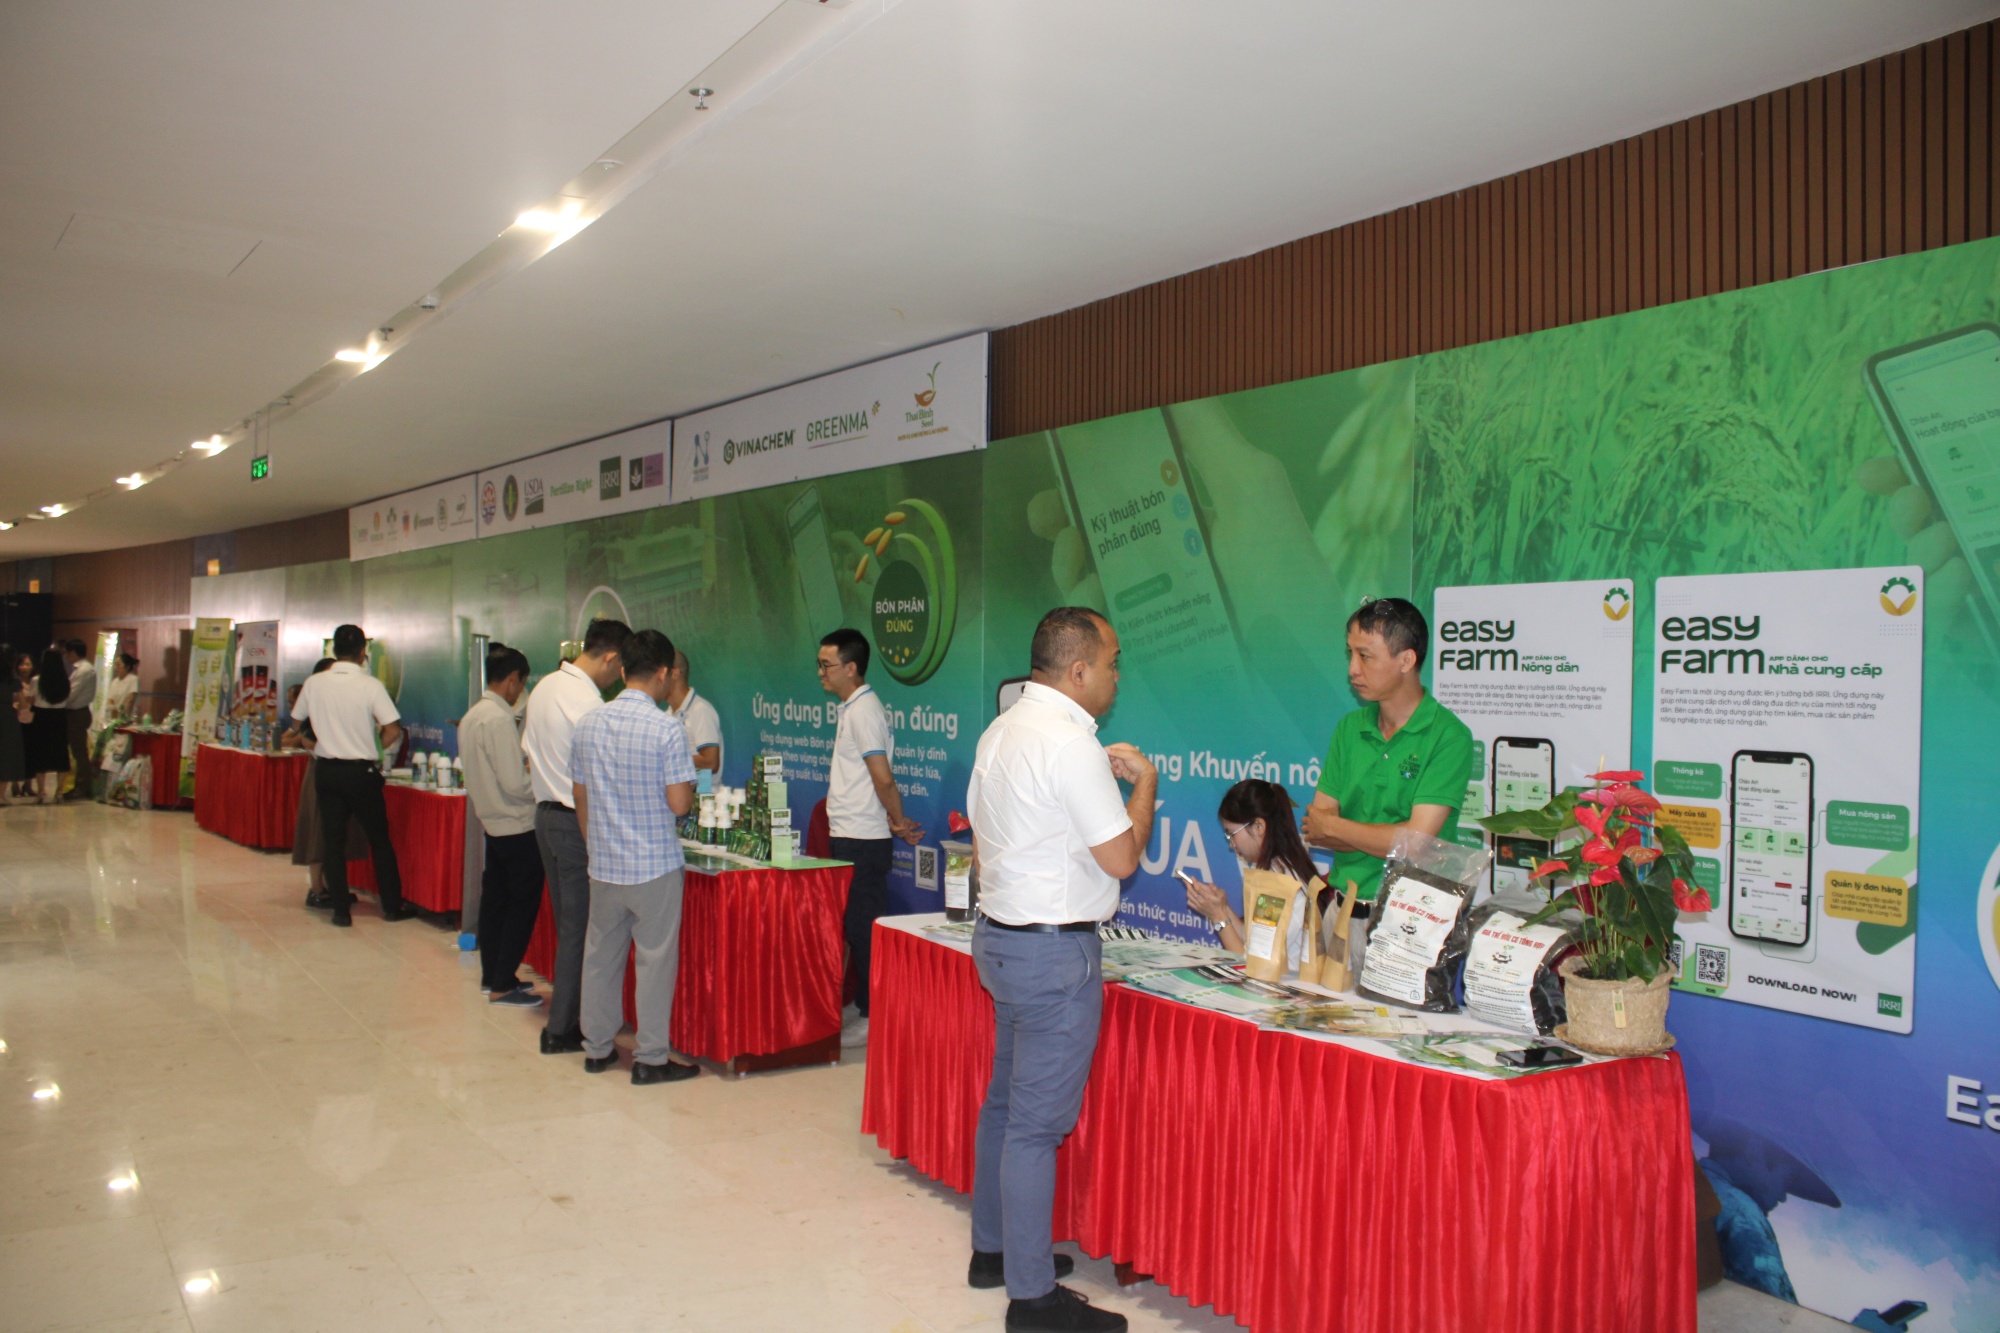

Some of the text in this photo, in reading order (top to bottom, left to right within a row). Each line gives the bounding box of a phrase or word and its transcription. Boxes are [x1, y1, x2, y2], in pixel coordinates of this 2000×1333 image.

[806, 410, 868, 442] GREENMA
[736, 431, 794, 458] VINACHEM
[524, 478, 544, 497] USDA
[576, 478, 592, 494] Right
[600, 469, 620, 489] IRRI
[1091, 489, 1165, 538] Kỹ thuật bón
[1097, 518, 1162, 559] phân đúng
[876, 596, 925, 614] BÓN PHÂN
[886, 617, 913, 632] ĐÚNG
[1440, 620, 1515, 642] easy
[1661, 615, 1760, 642] easy
[1439, 649, 1518, 671] Farm
[1521, 661, 1579, 675] Nông dân
[1660, 648, 1765, 674] Farm
[1768, 663, 1883, 679] Nhà cung cấp
[752, 693, 780, 726] Ứng
[784, 699, 822, 729] dụng
[910, 705, 958, 740] đúng
[775, 732, 792, 748] dụng
[794, 735, 809, 747] web
[810, 735, 825, 748] Bón
[783, 751, 941, 781] theo vùng tác lúa,
[1190, 750, 1280, 786] Khuyến
[796, 769, 929, 796] suất lúa dân.
[1684, 810, 1696, 818] của
[1839, 809, 1896, 820] Mua nông sản
[1139, 800, 1214, 885] ÚA
[1831, 879, 1902, 896] Quản lý đơn hàng
[1138, 902, 1166, 921] thức
[1169, 909, 1201, 928] quản
[1748, 975, 1857, 1003] DOWNLOAD NOW!
